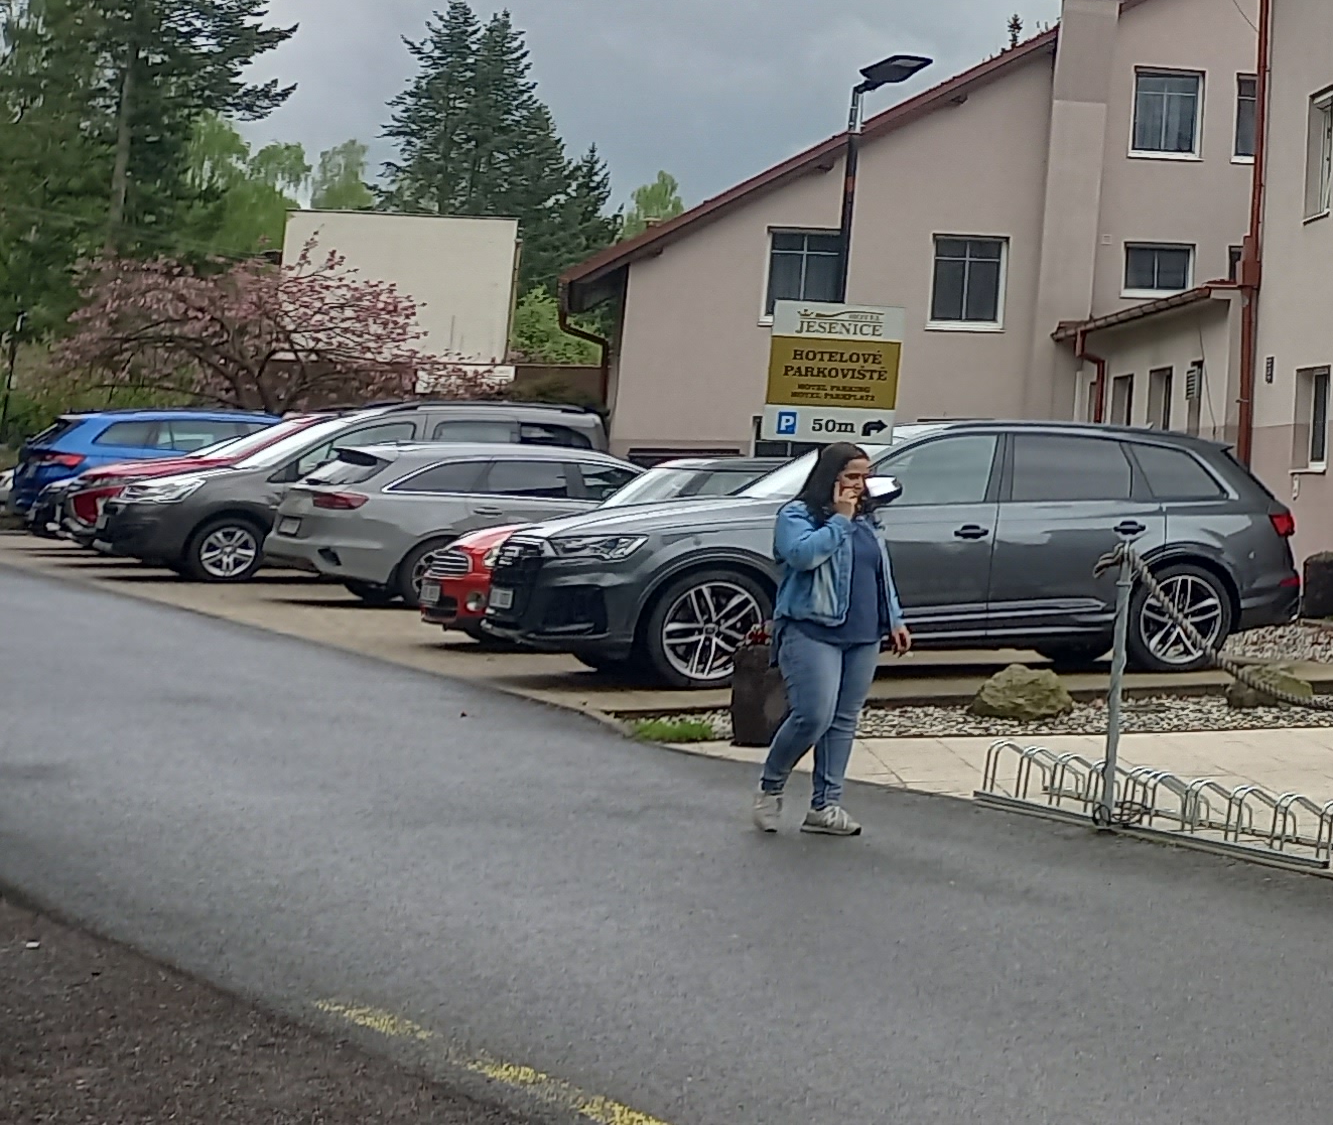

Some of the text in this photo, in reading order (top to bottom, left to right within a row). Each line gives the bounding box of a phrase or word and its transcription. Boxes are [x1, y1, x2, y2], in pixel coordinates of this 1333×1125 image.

[795, 320, 884, 336] JESENICE
[792, 349, 883, 365] HOTELOVÉ
[783, 365, 888, 381] PARKOVIŠTĚ
[811, 418, 856, 433] 50m
